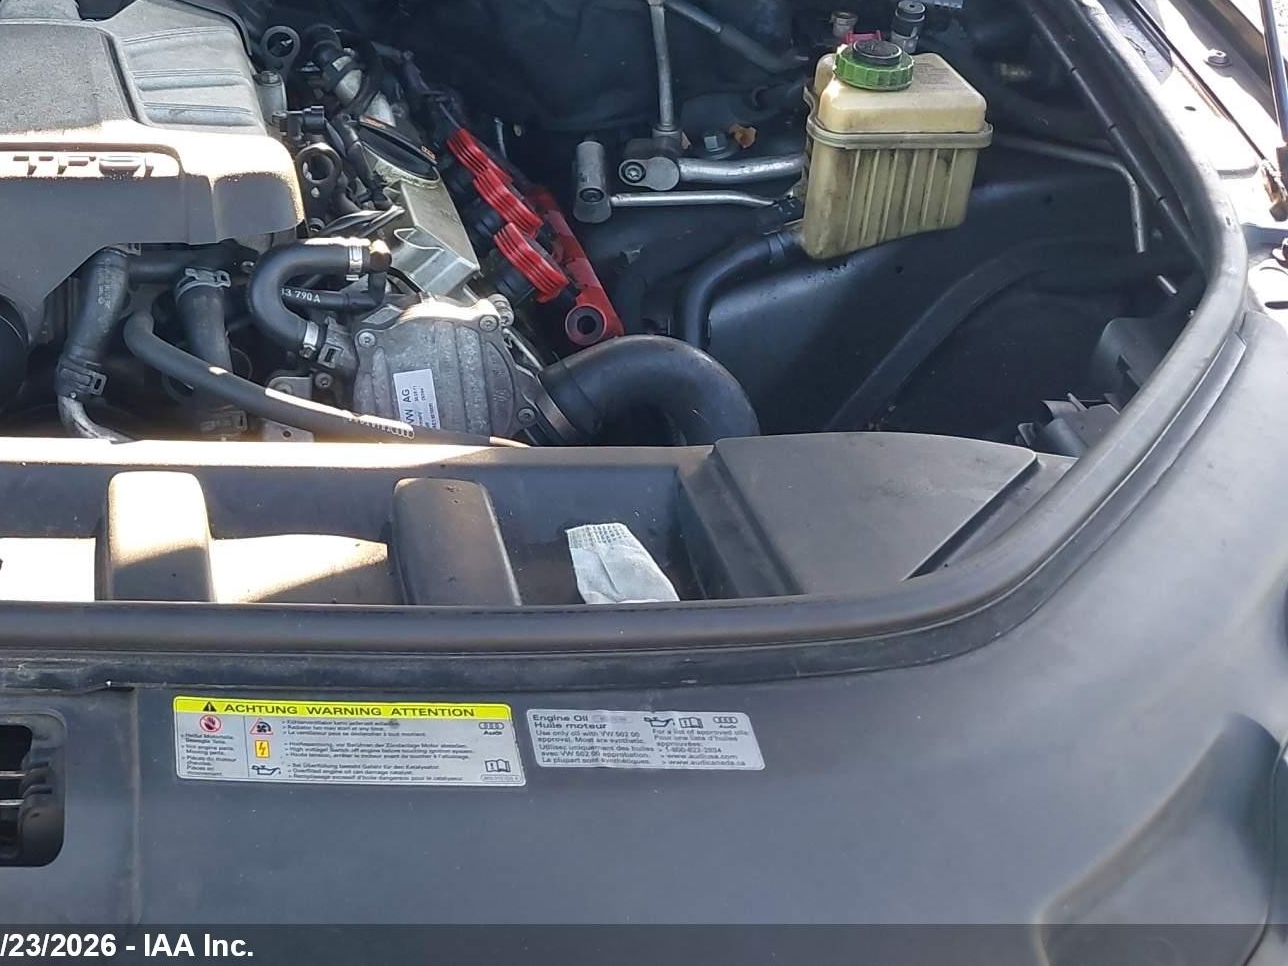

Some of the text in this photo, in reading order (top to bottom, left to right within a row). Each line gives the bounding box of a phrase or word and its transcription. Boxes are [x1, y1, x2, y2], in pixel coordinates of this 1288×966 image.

[401, 388, 412, 403] AG
[224, 704, 475, 718] ACHTUNG WARNING ATTENTION
[532, 714, 570, 722] Engine
[574, 714, 588, 722] Oil
